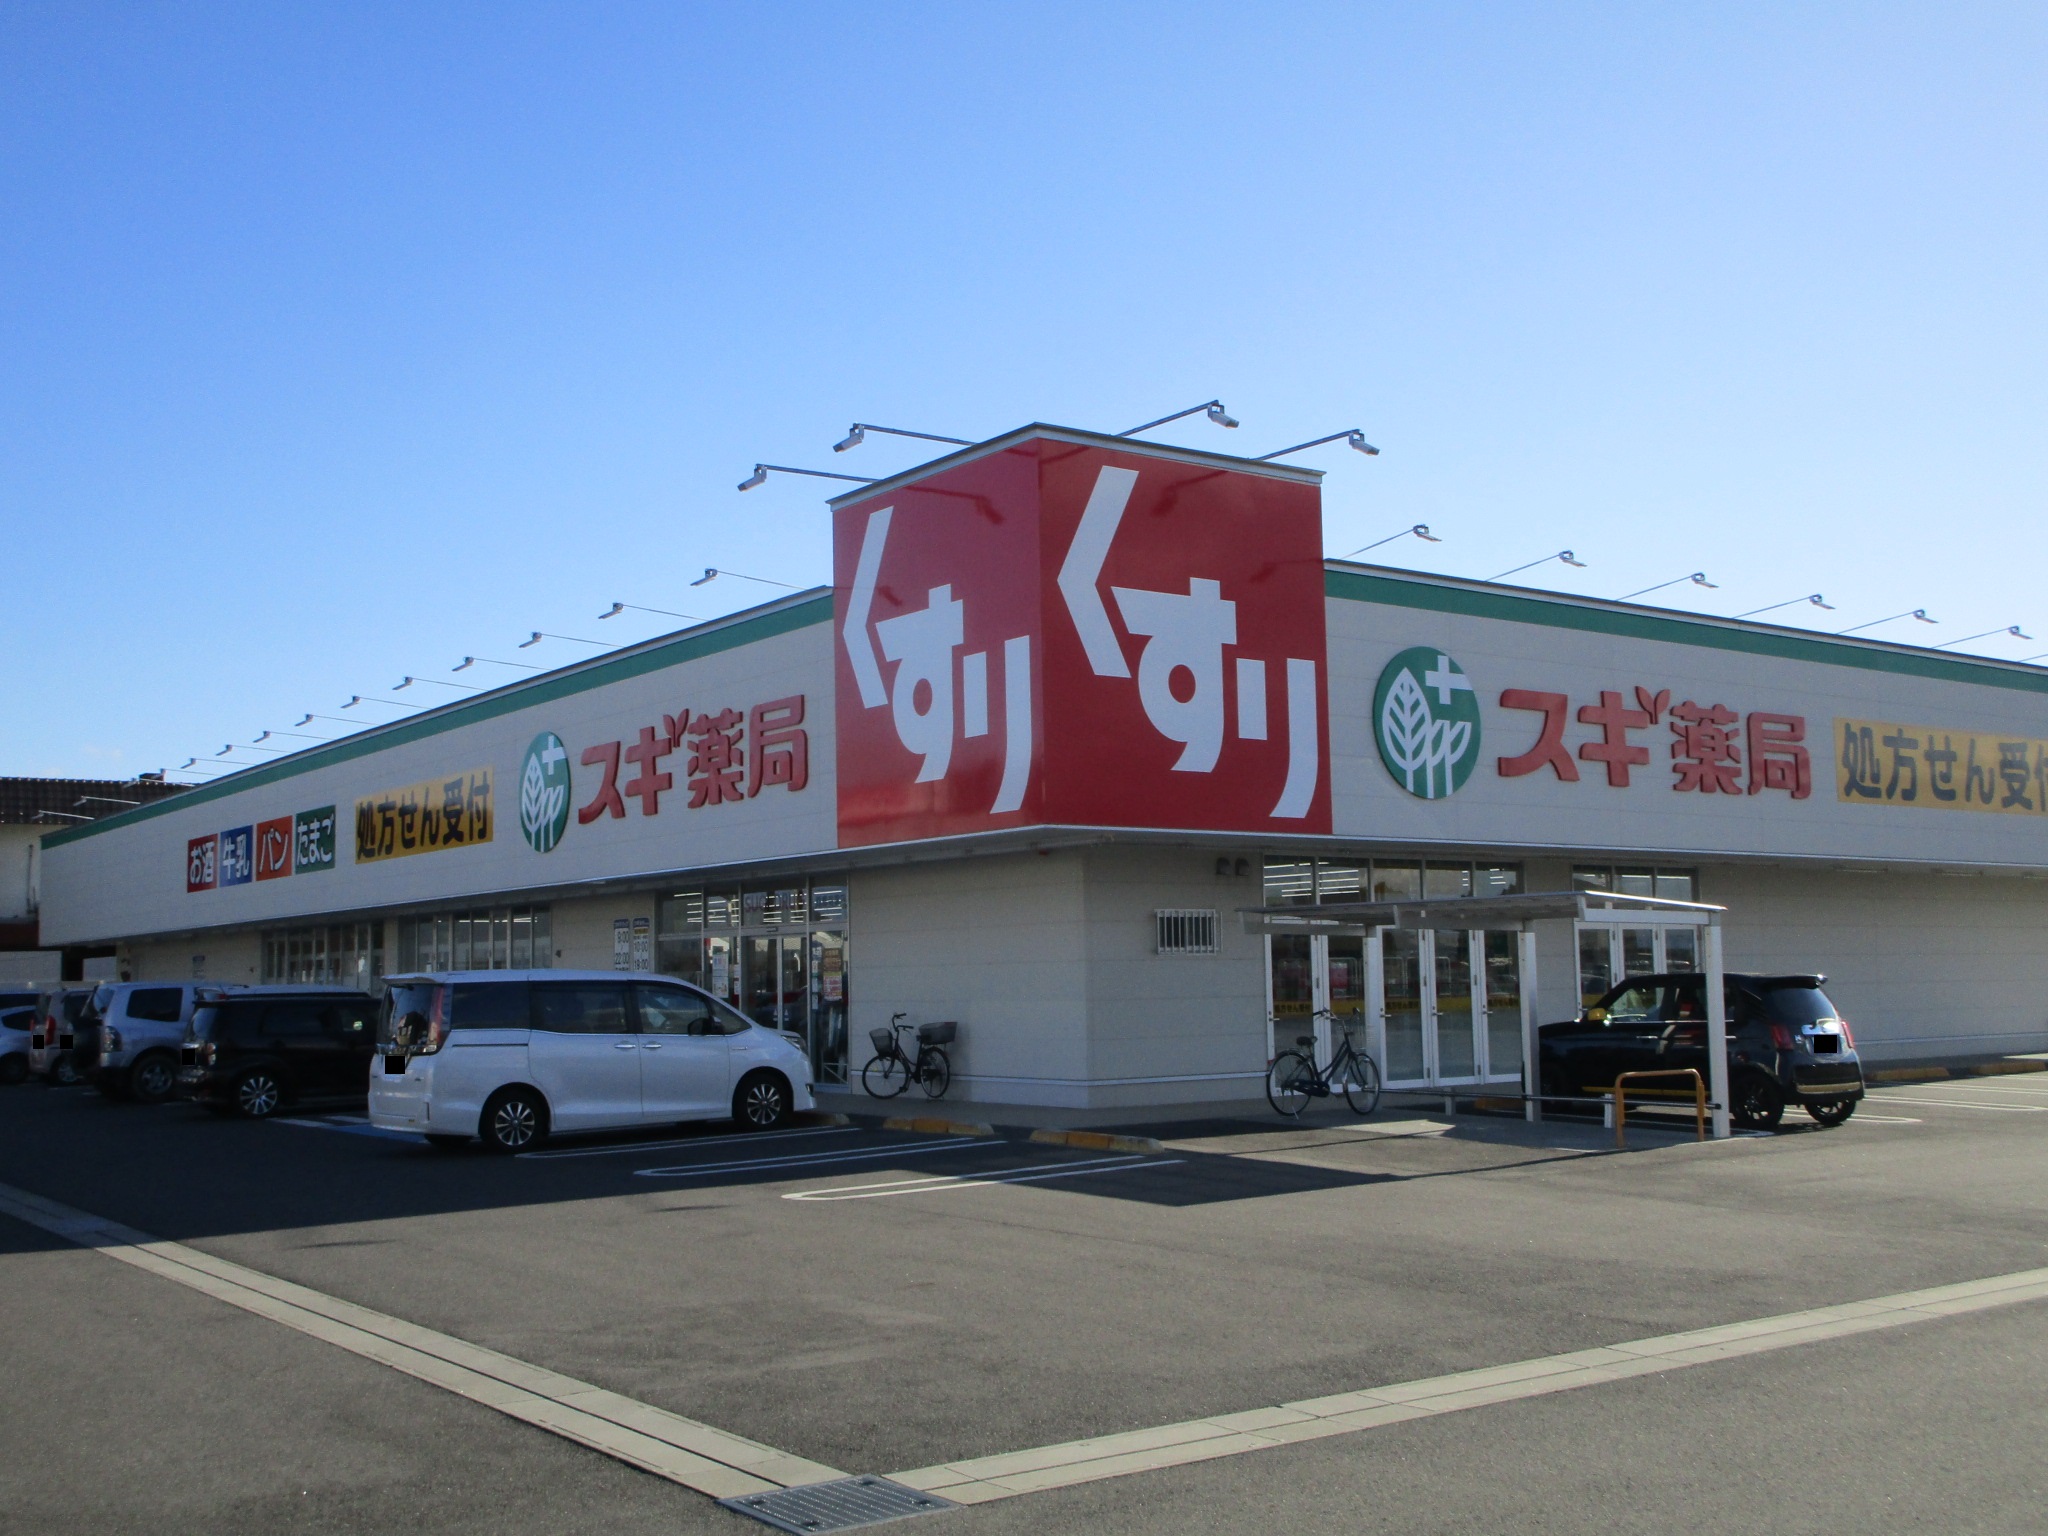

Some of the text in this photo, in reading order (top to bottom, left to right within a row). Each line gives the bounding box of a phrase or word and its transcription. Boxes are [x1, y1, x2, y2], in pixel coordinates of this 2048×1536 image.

[842, 505, 1032, 814] くすり
[1057, 465, 1318, 818] くすり
[578, 694, 809, 825] スギ薬局
[1498, 685, 1812, 800] スギ薬局
[222, 834, 250, 880] 牛乳
[259, 827, 289, 873] パン
[297, 813, 335, 866] たまご
[356, 770, 490, 861] 処方せん受付
[190, 841, 215, 885] お酒
